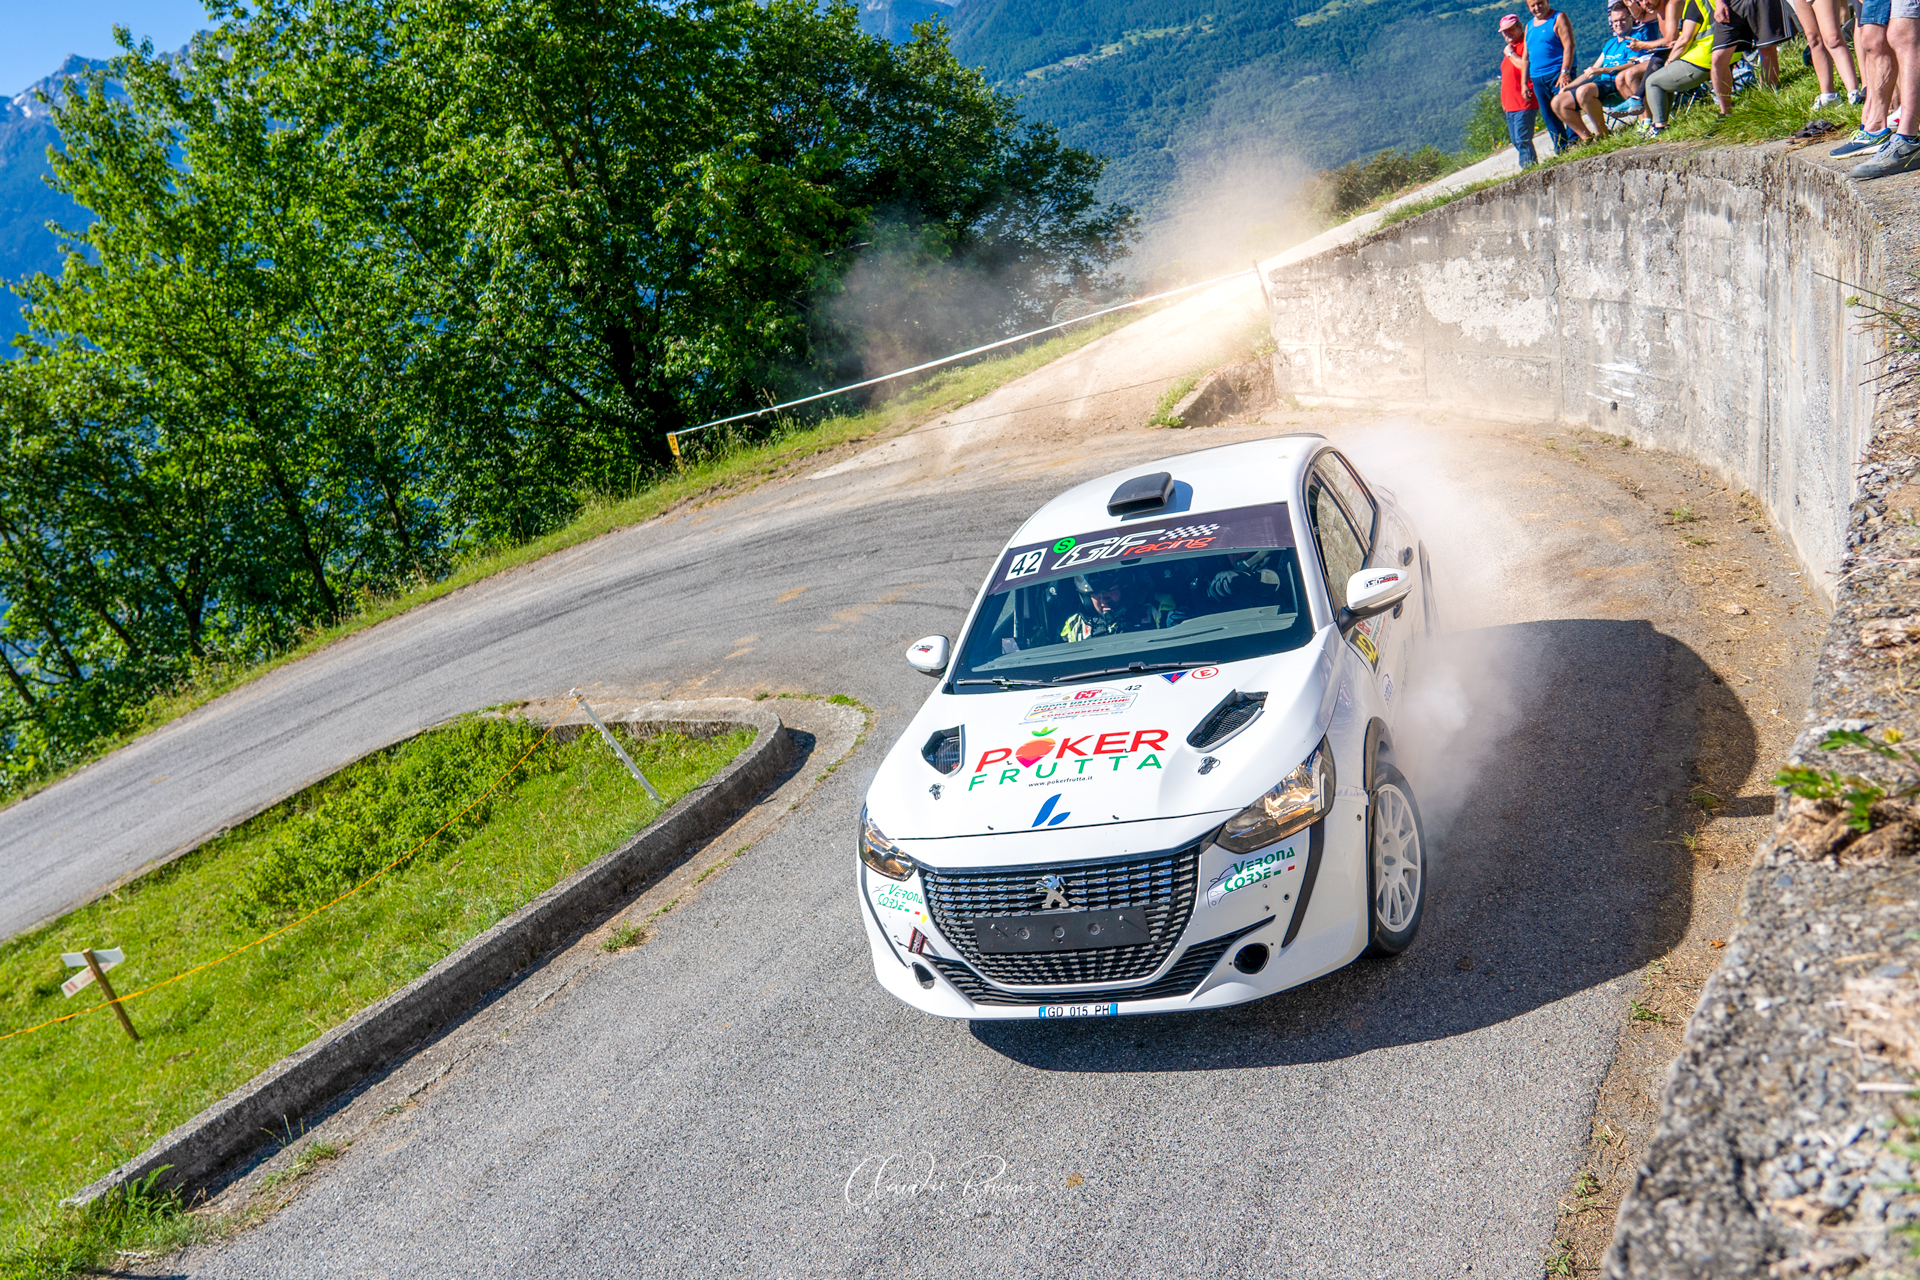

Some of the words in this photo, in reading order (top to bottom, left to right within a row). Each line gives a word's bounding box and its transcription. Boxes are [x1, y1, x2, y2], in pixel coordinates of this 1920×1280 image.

[1122, 536, 1217, 556] racing
[1010, 551, 1043, 576] 42
[975, 729, 1170, 773] POKER
[968, 754, 1162, 791] FRUTTA
[1028, 775, 1093, 788] www.pokerfrutta.it
[1233, 846, 1296, 875] VERONA
[1224, 867, 1271, 892] CORSE
[1047, 1006, 1064, 1018] GD
[1069, 1006, 1088, 1017] 015
[1094, 1004, 1110, 1016] PH
